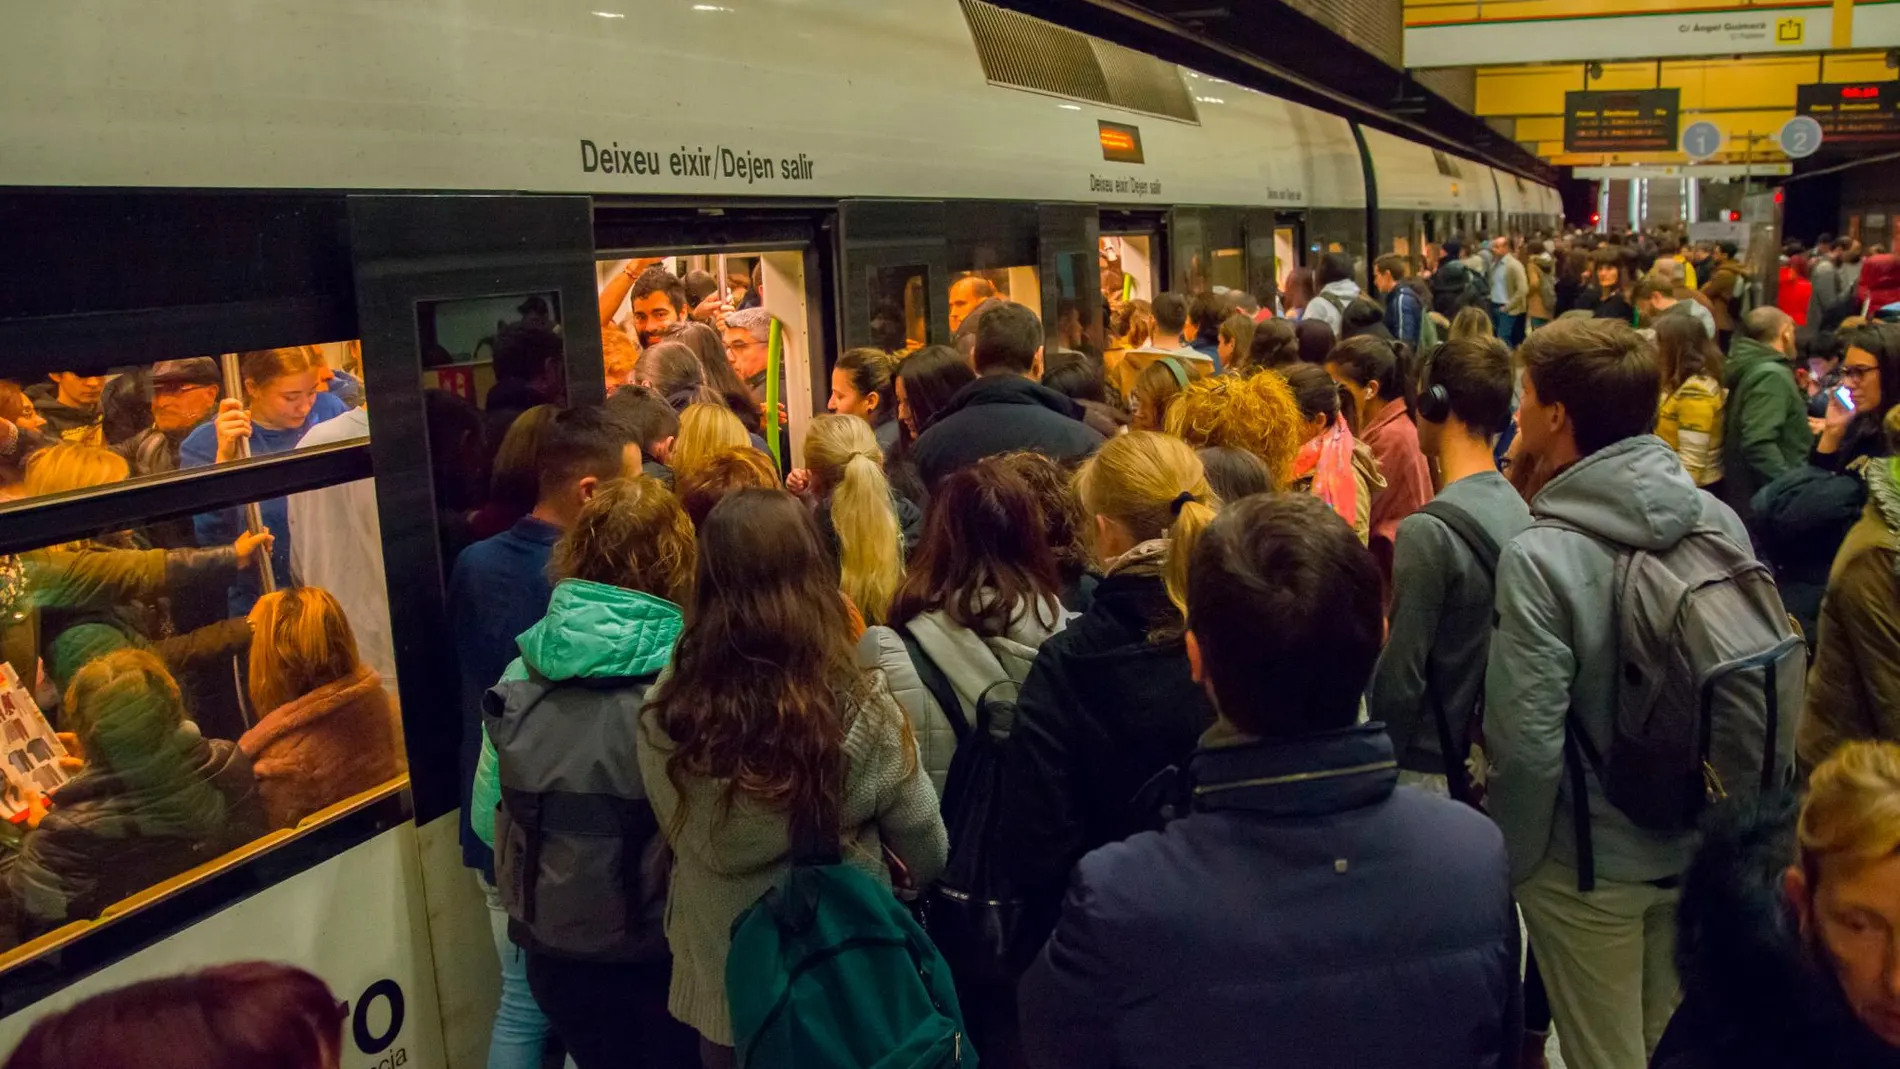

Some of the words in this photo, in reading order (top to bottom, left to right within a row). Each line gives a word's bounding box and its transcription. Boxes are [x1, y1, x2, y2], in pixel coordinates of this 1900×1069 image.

[1696, 135, 1706, 153] 1
[1793, 132, 1807, 151] 2
[580, 139, 660, 176] Deixeu
[669, 145, 775, 184] eixir/Dejen
[781, 153, 814, 180] salir
[1090, 173, 1114, 193] Deixeu
[1149, 179, 1161, 195] salir
